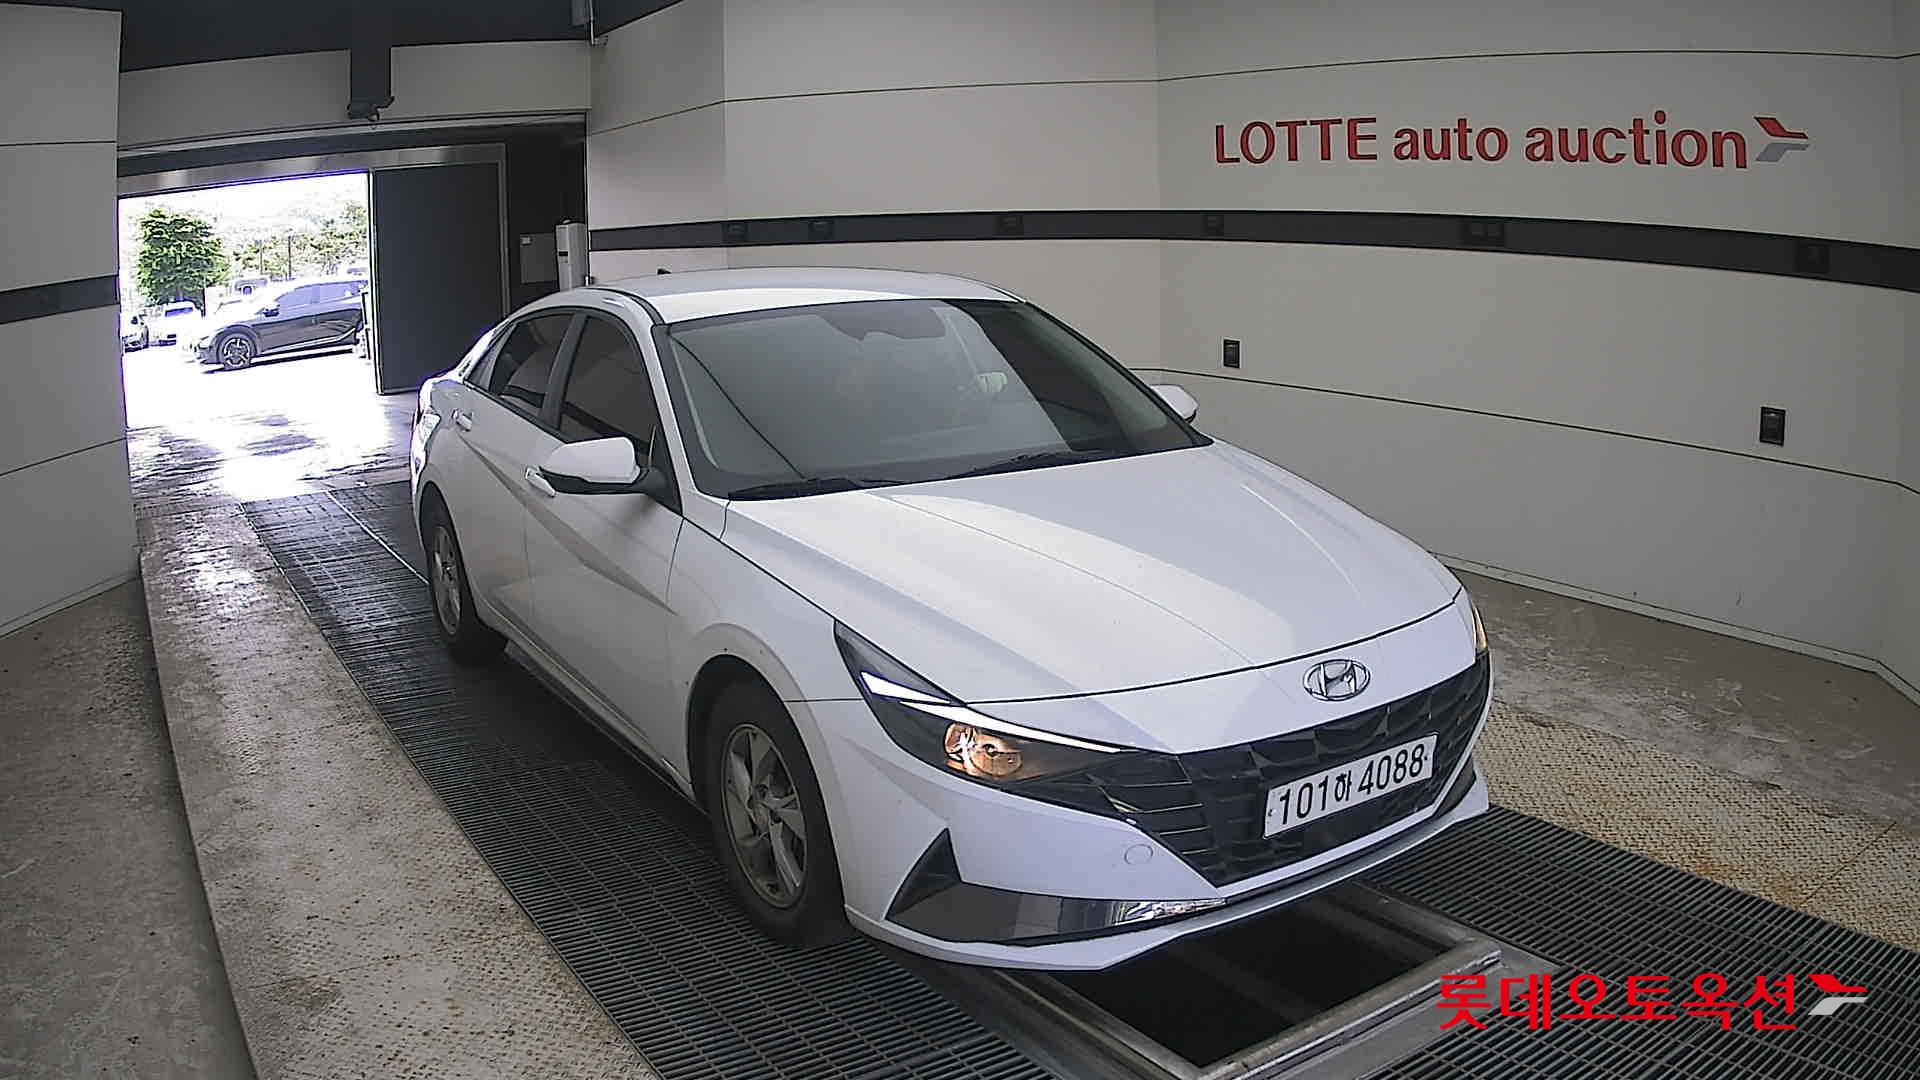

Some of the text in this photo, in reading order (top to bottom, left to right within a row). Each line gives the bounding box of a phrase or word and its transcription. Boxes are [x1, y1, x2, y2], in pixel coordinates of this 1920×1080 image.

[1215, 110, 1748, 169] LOTTE auto auction
[1279, 743, 1425, 825] 101하 4088
